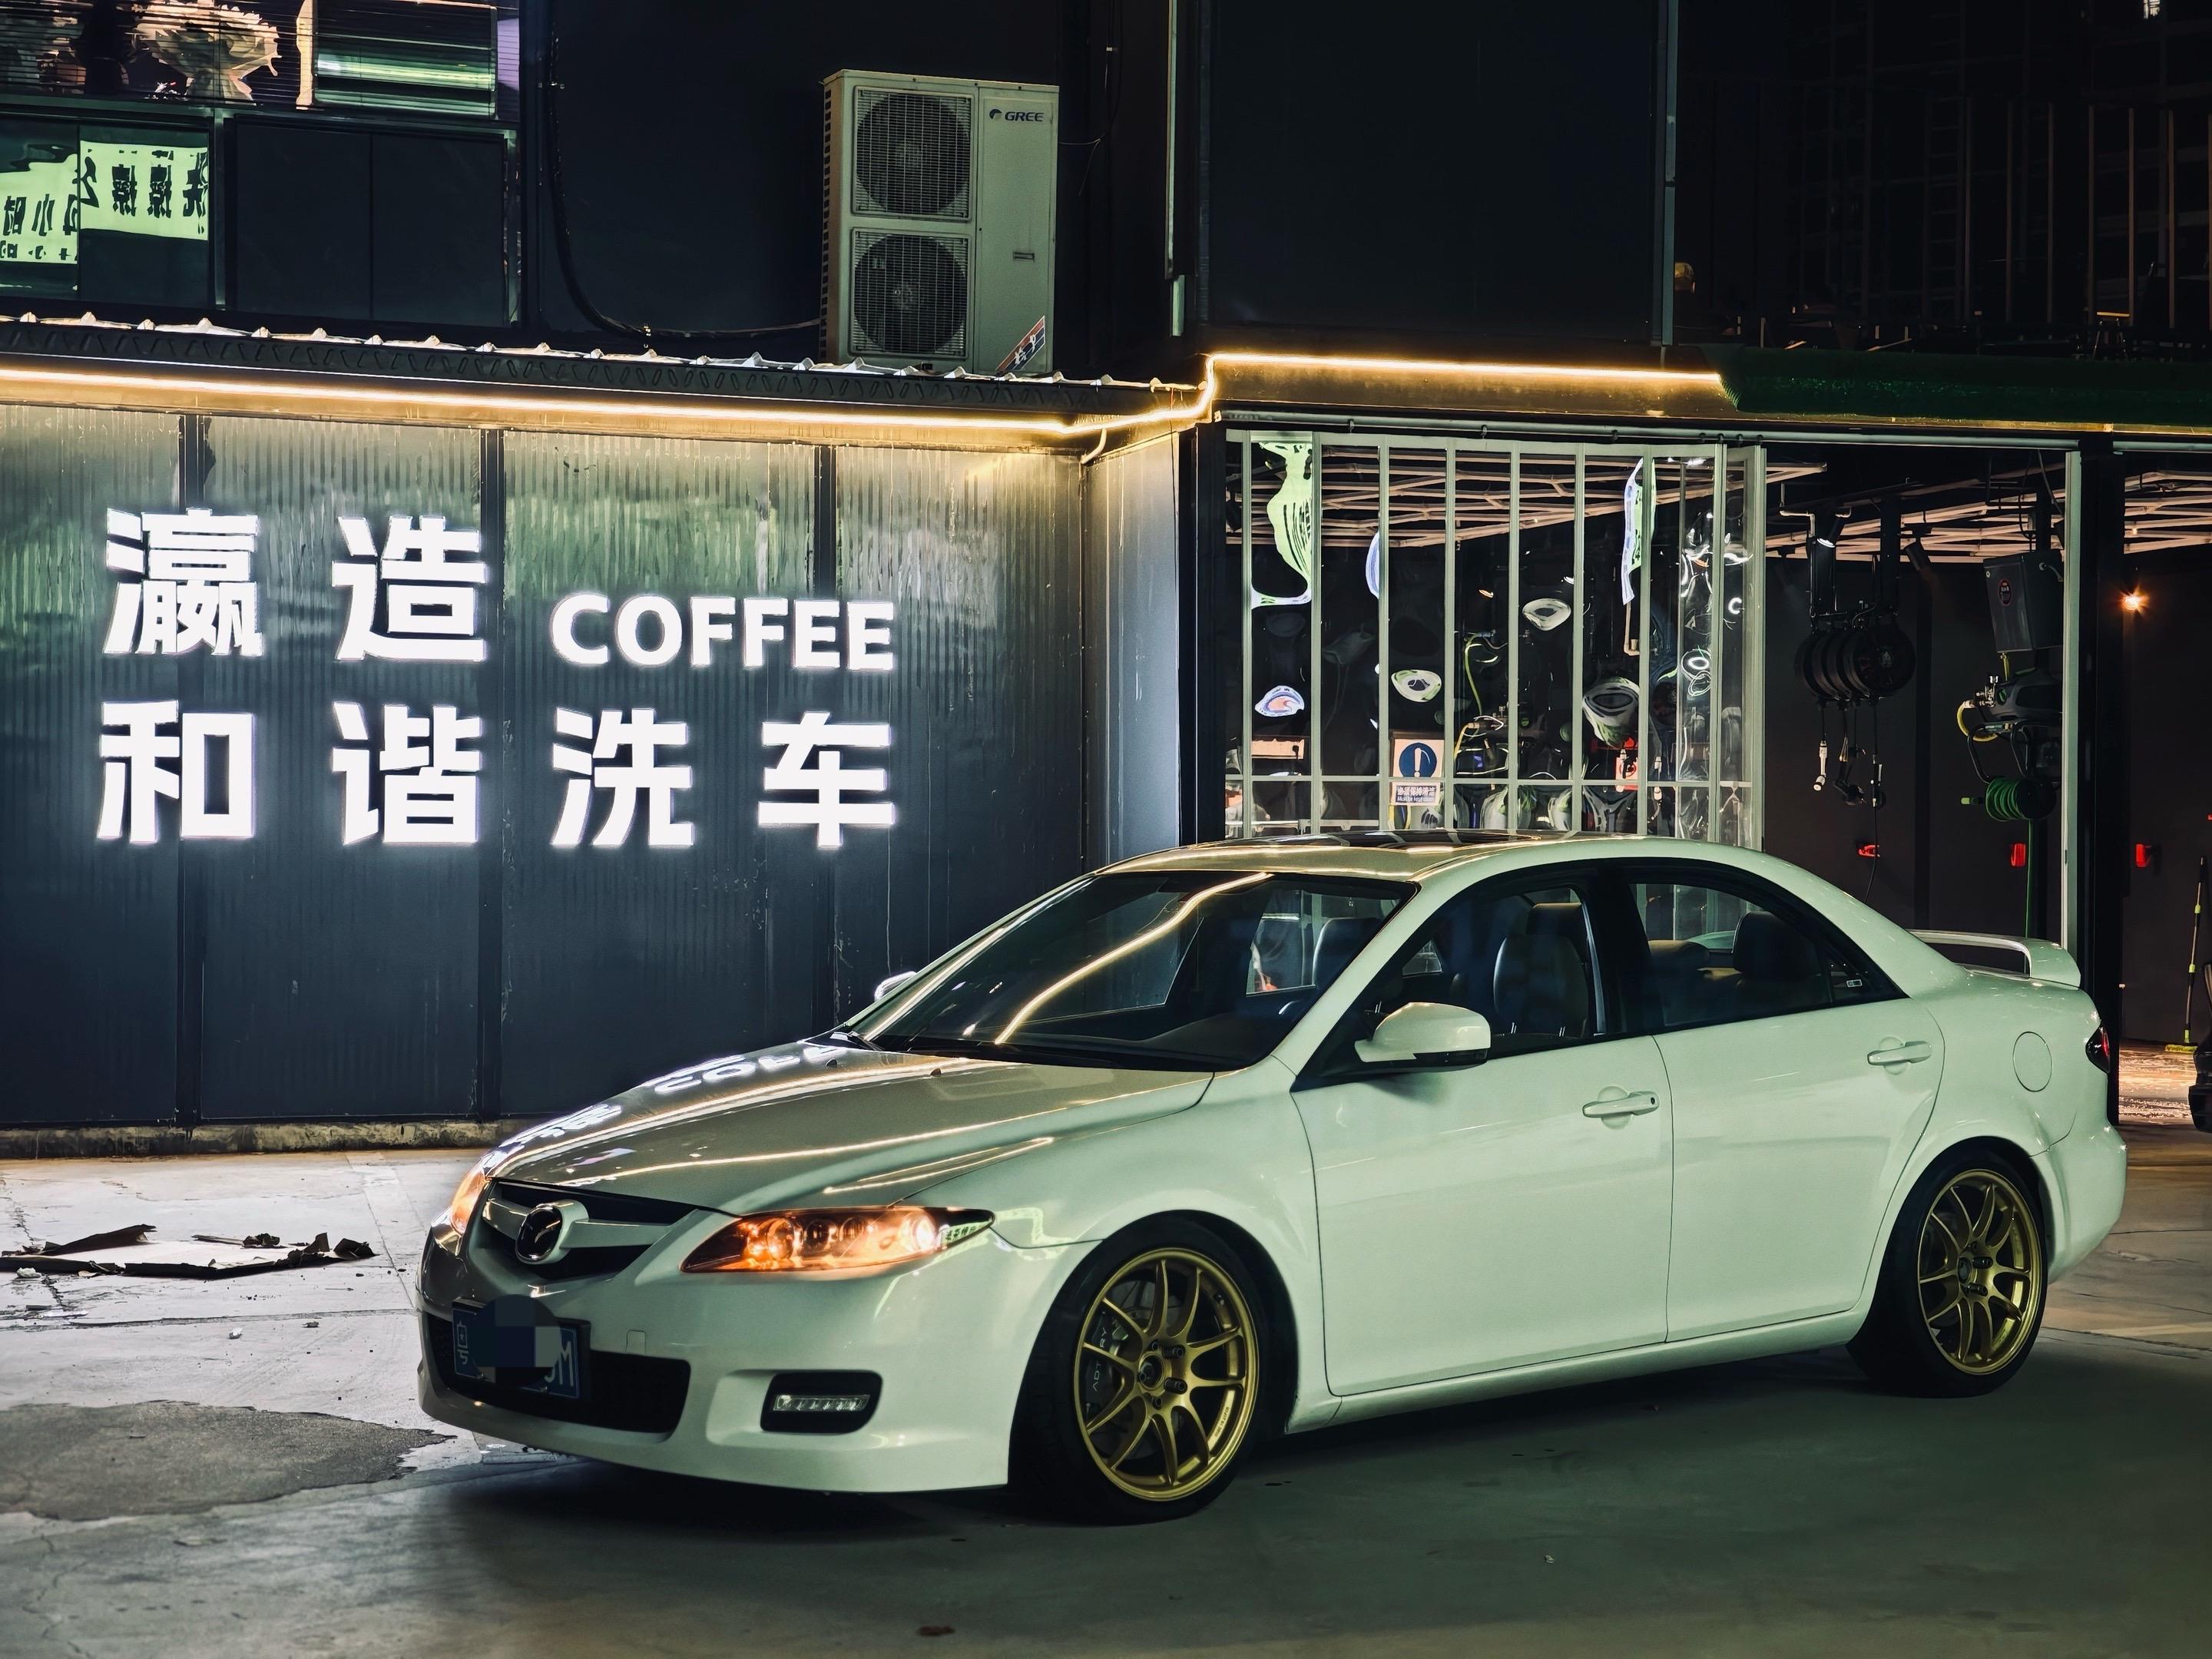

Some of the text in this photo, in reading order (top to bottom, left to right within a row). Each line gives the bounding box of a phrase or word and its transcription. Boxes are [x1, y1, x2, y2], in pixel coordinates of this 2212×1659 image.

[1005, 111, 1045, 122] GREE
[103, 507, 896, 672] 瀛造 COFFEE
[97, 700, 896, 847] 和谐洗车
